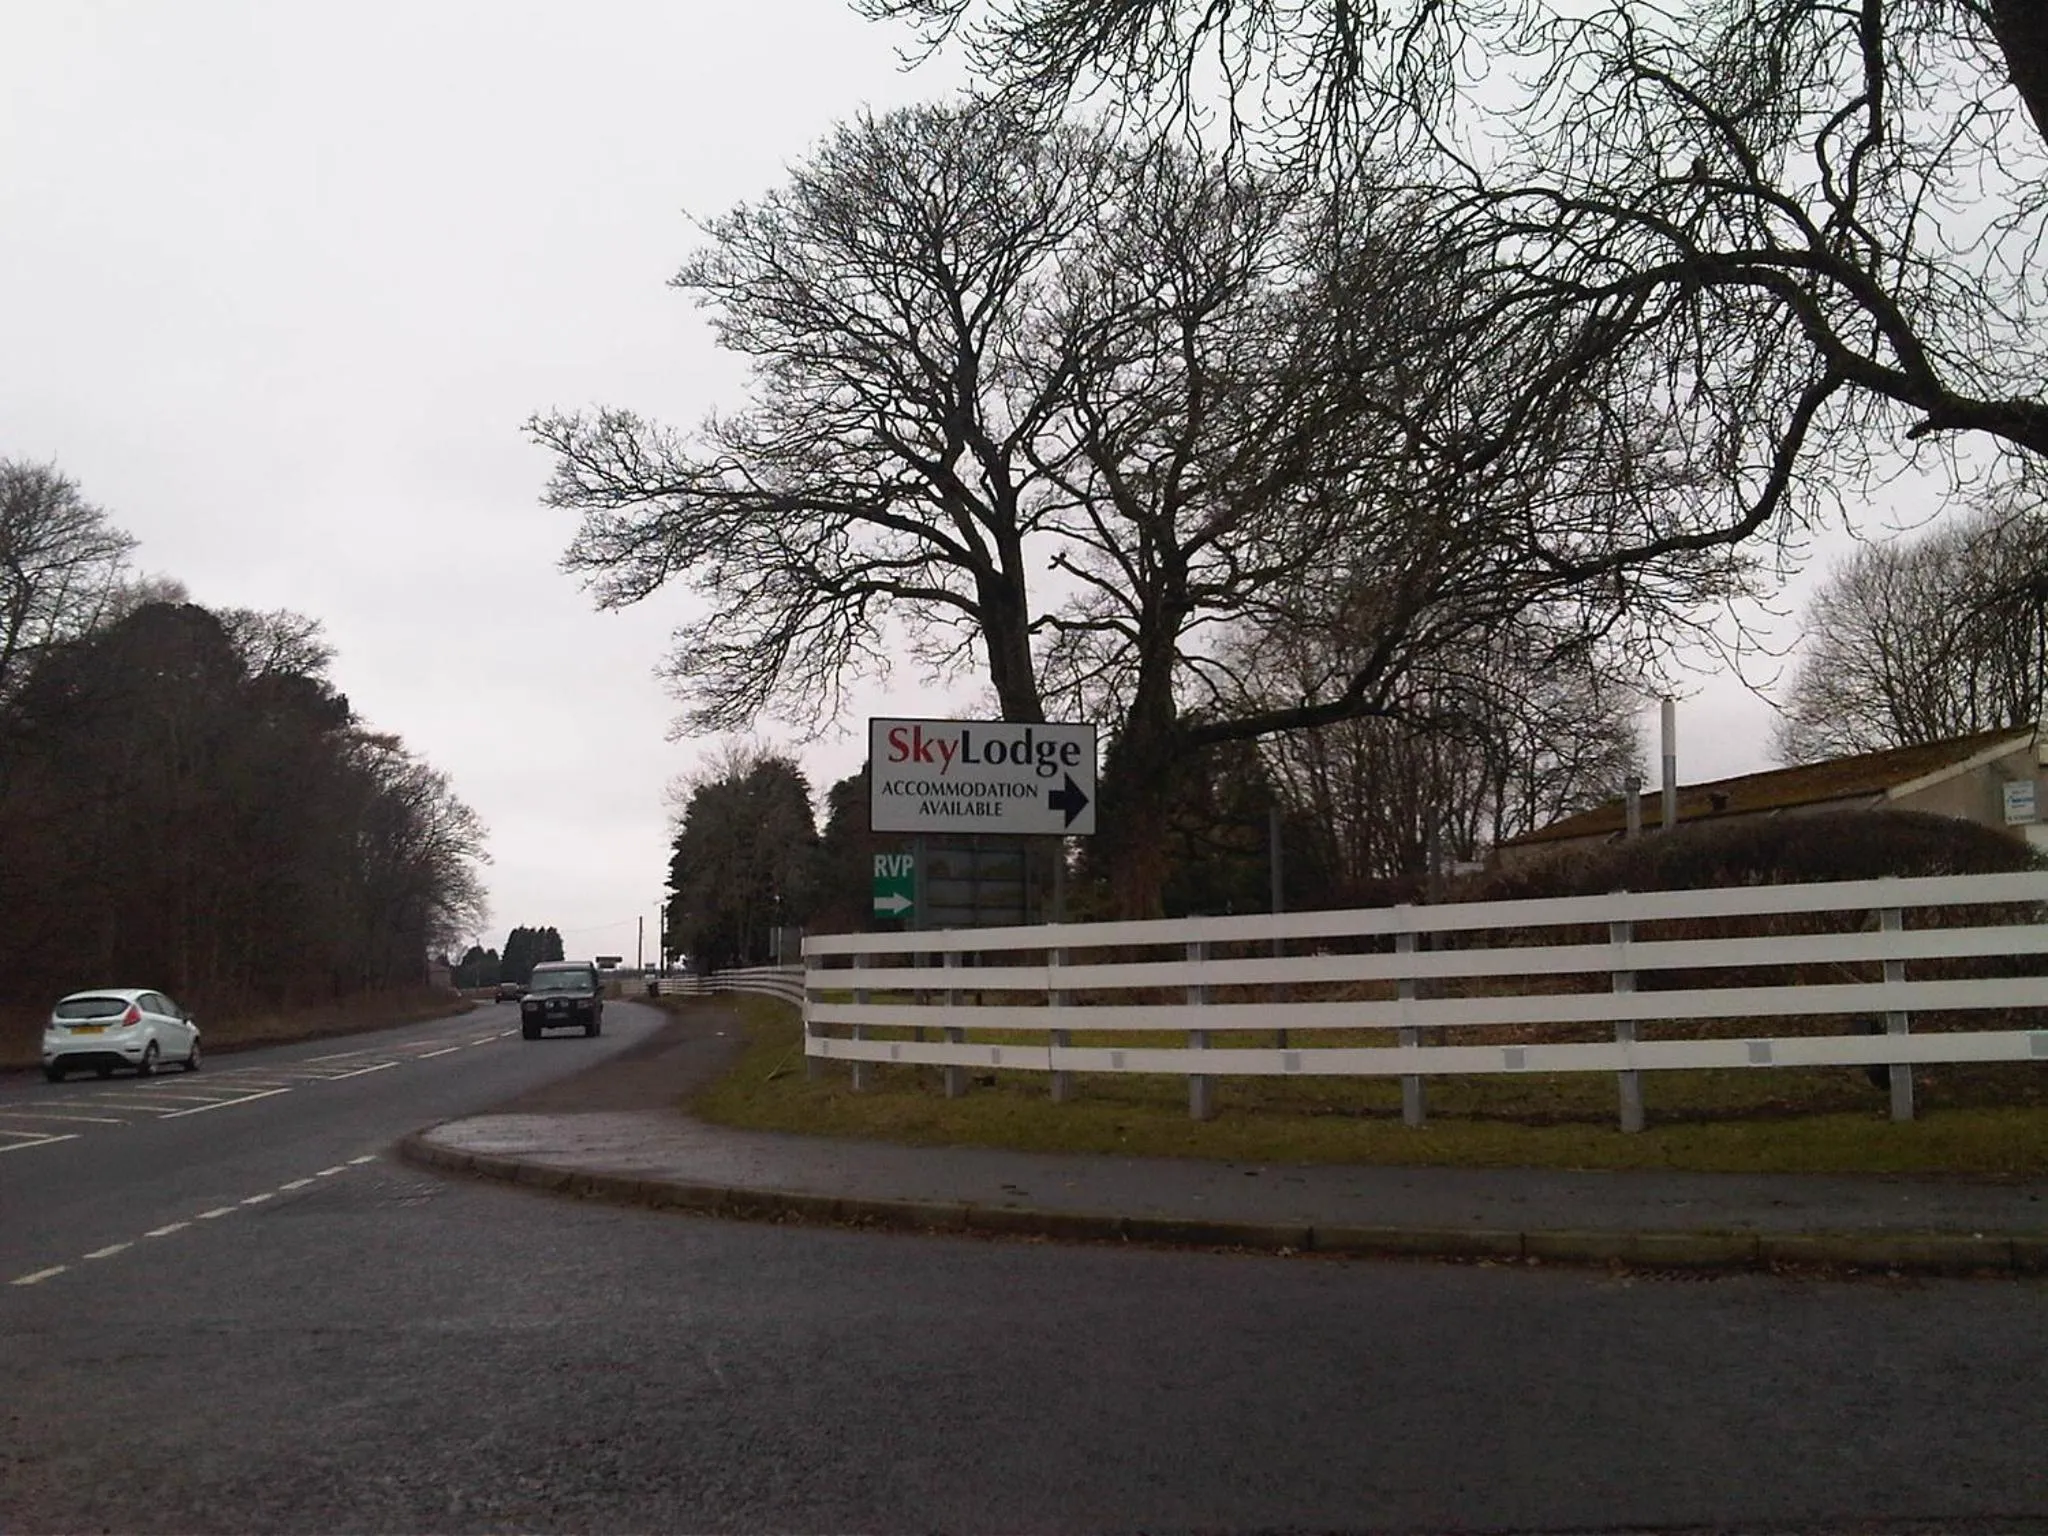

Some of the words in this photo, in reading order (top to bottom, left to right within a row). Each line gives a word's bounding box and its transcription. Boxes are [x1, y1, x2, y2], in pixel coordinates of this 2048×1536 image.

[887, 725, 1081, 778] SkyLodge
[881, 780, 1038, 798] ACCOMMODATION
[919, 801, 1003, 817] AVAILABLE
[874, 854, 914, 878] RVP
